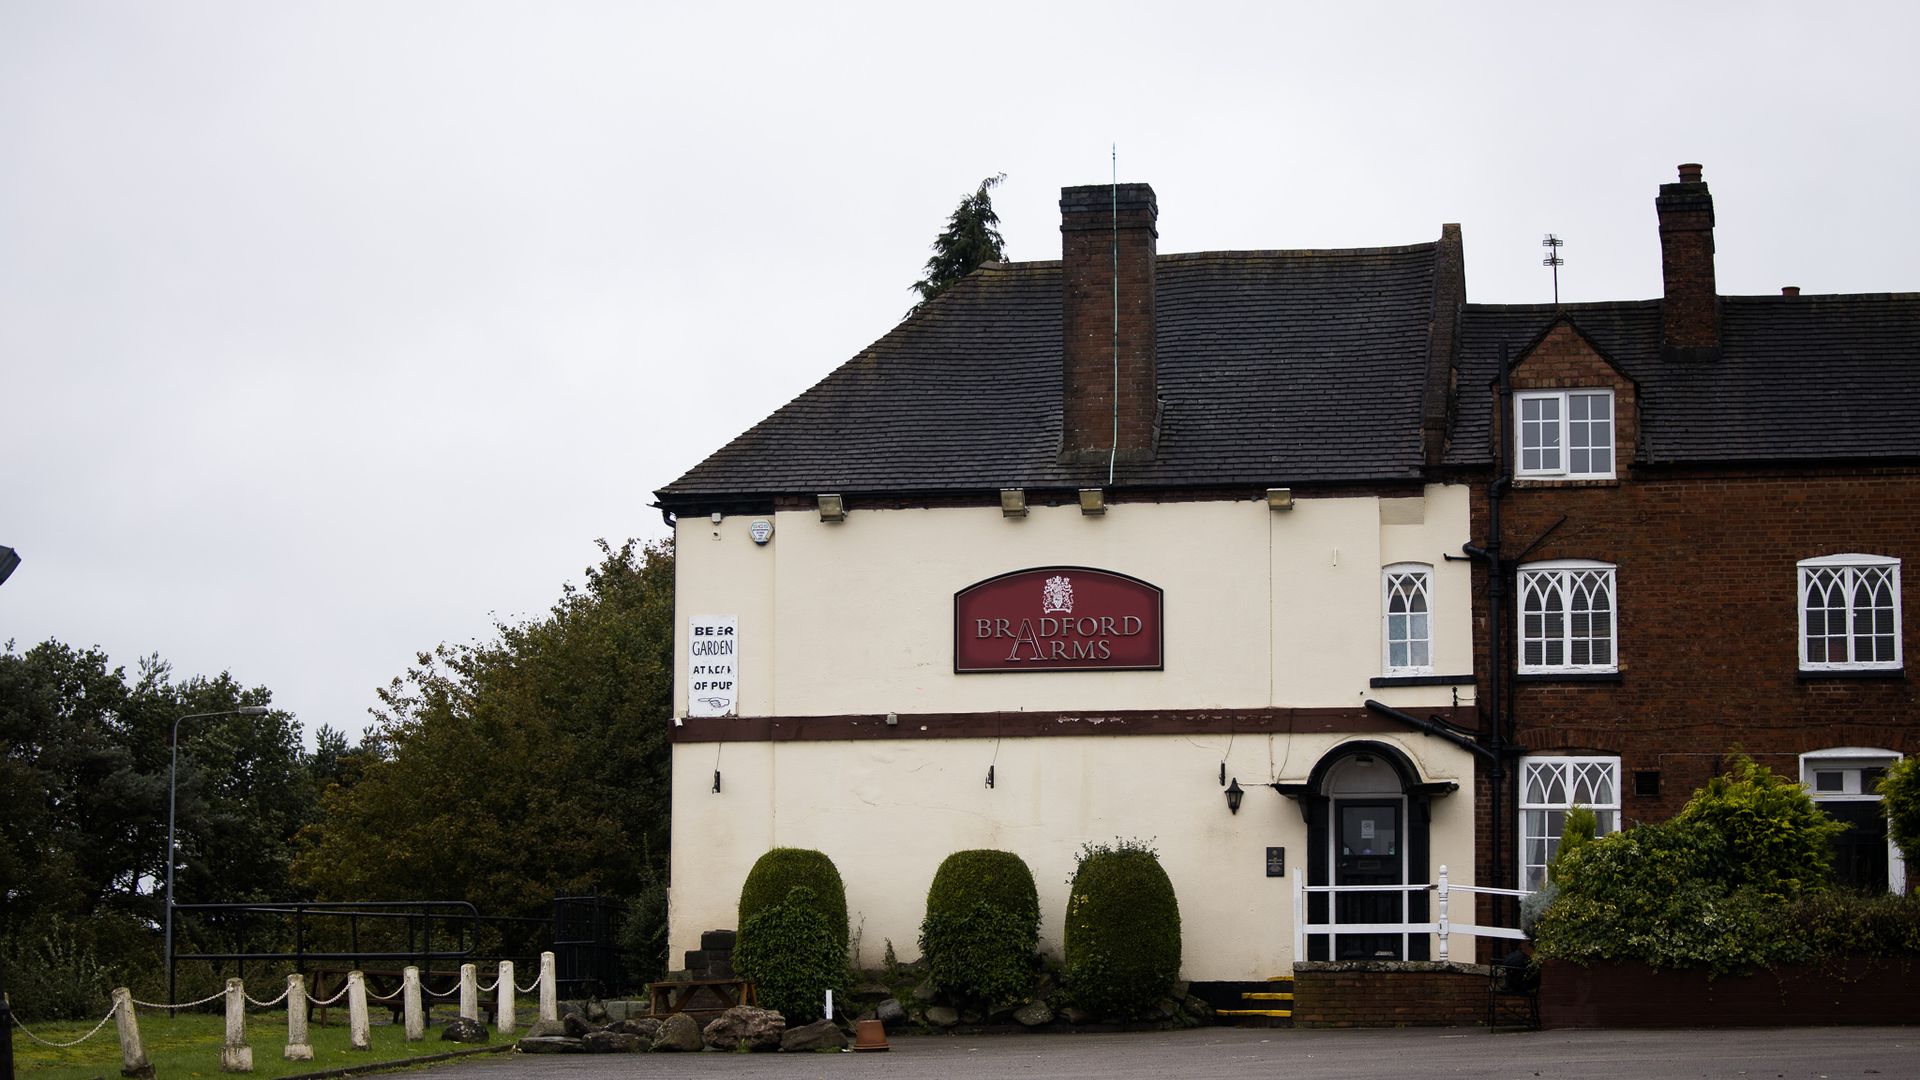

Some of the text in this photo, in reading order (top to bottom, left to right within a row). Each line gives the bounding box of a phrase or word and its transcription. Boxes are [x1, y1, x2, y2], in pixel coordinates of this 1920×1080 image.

[694, 626, 734, 636] BEER
[975, 616, 1143, 661] BRADFORD
[1005, 618, 1112, 661] ARMS
[692, 639, 733, 656] GARDEN
[693, 665, 706, 674] AT
[694, 681, 708, 691] OF
